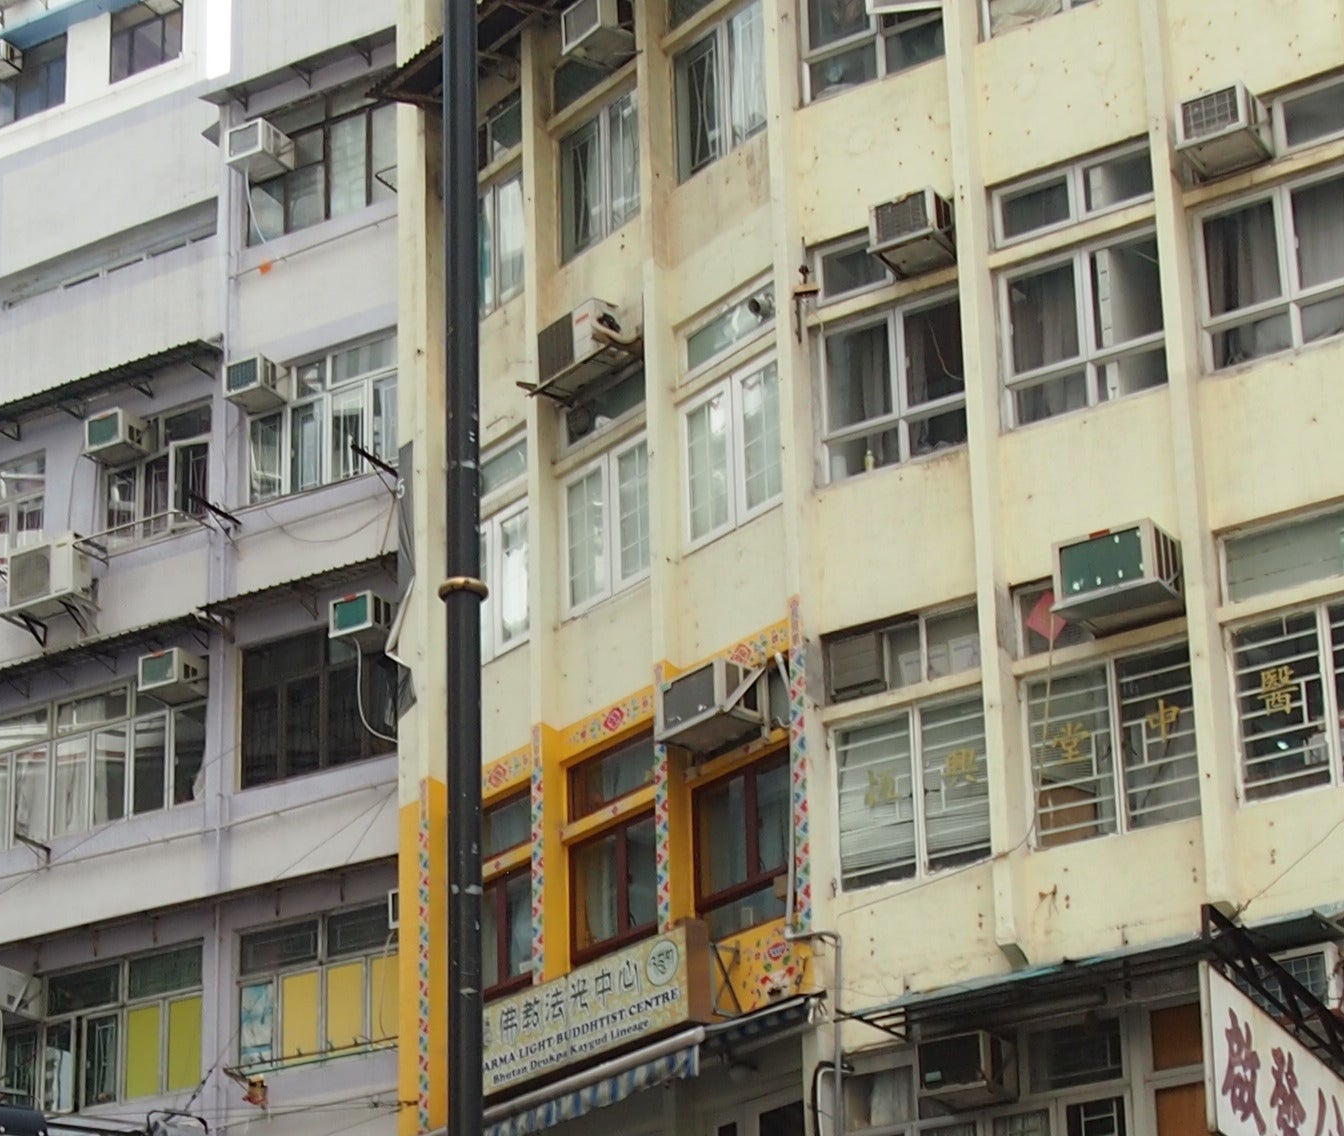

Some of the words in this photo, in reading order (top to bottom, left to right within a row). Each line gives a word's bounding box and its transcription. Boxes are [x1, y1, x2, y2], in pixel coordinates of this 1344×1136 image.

[484, 960, 642, 1047] 佛教法光中心
[484, 1050, 517, 1073] ARMA
[518, 1037, 555, 1062] LIGHT
[628, 986, 681, 1017] CENTRE
[609, 1019, 650, 1042] Lineage
